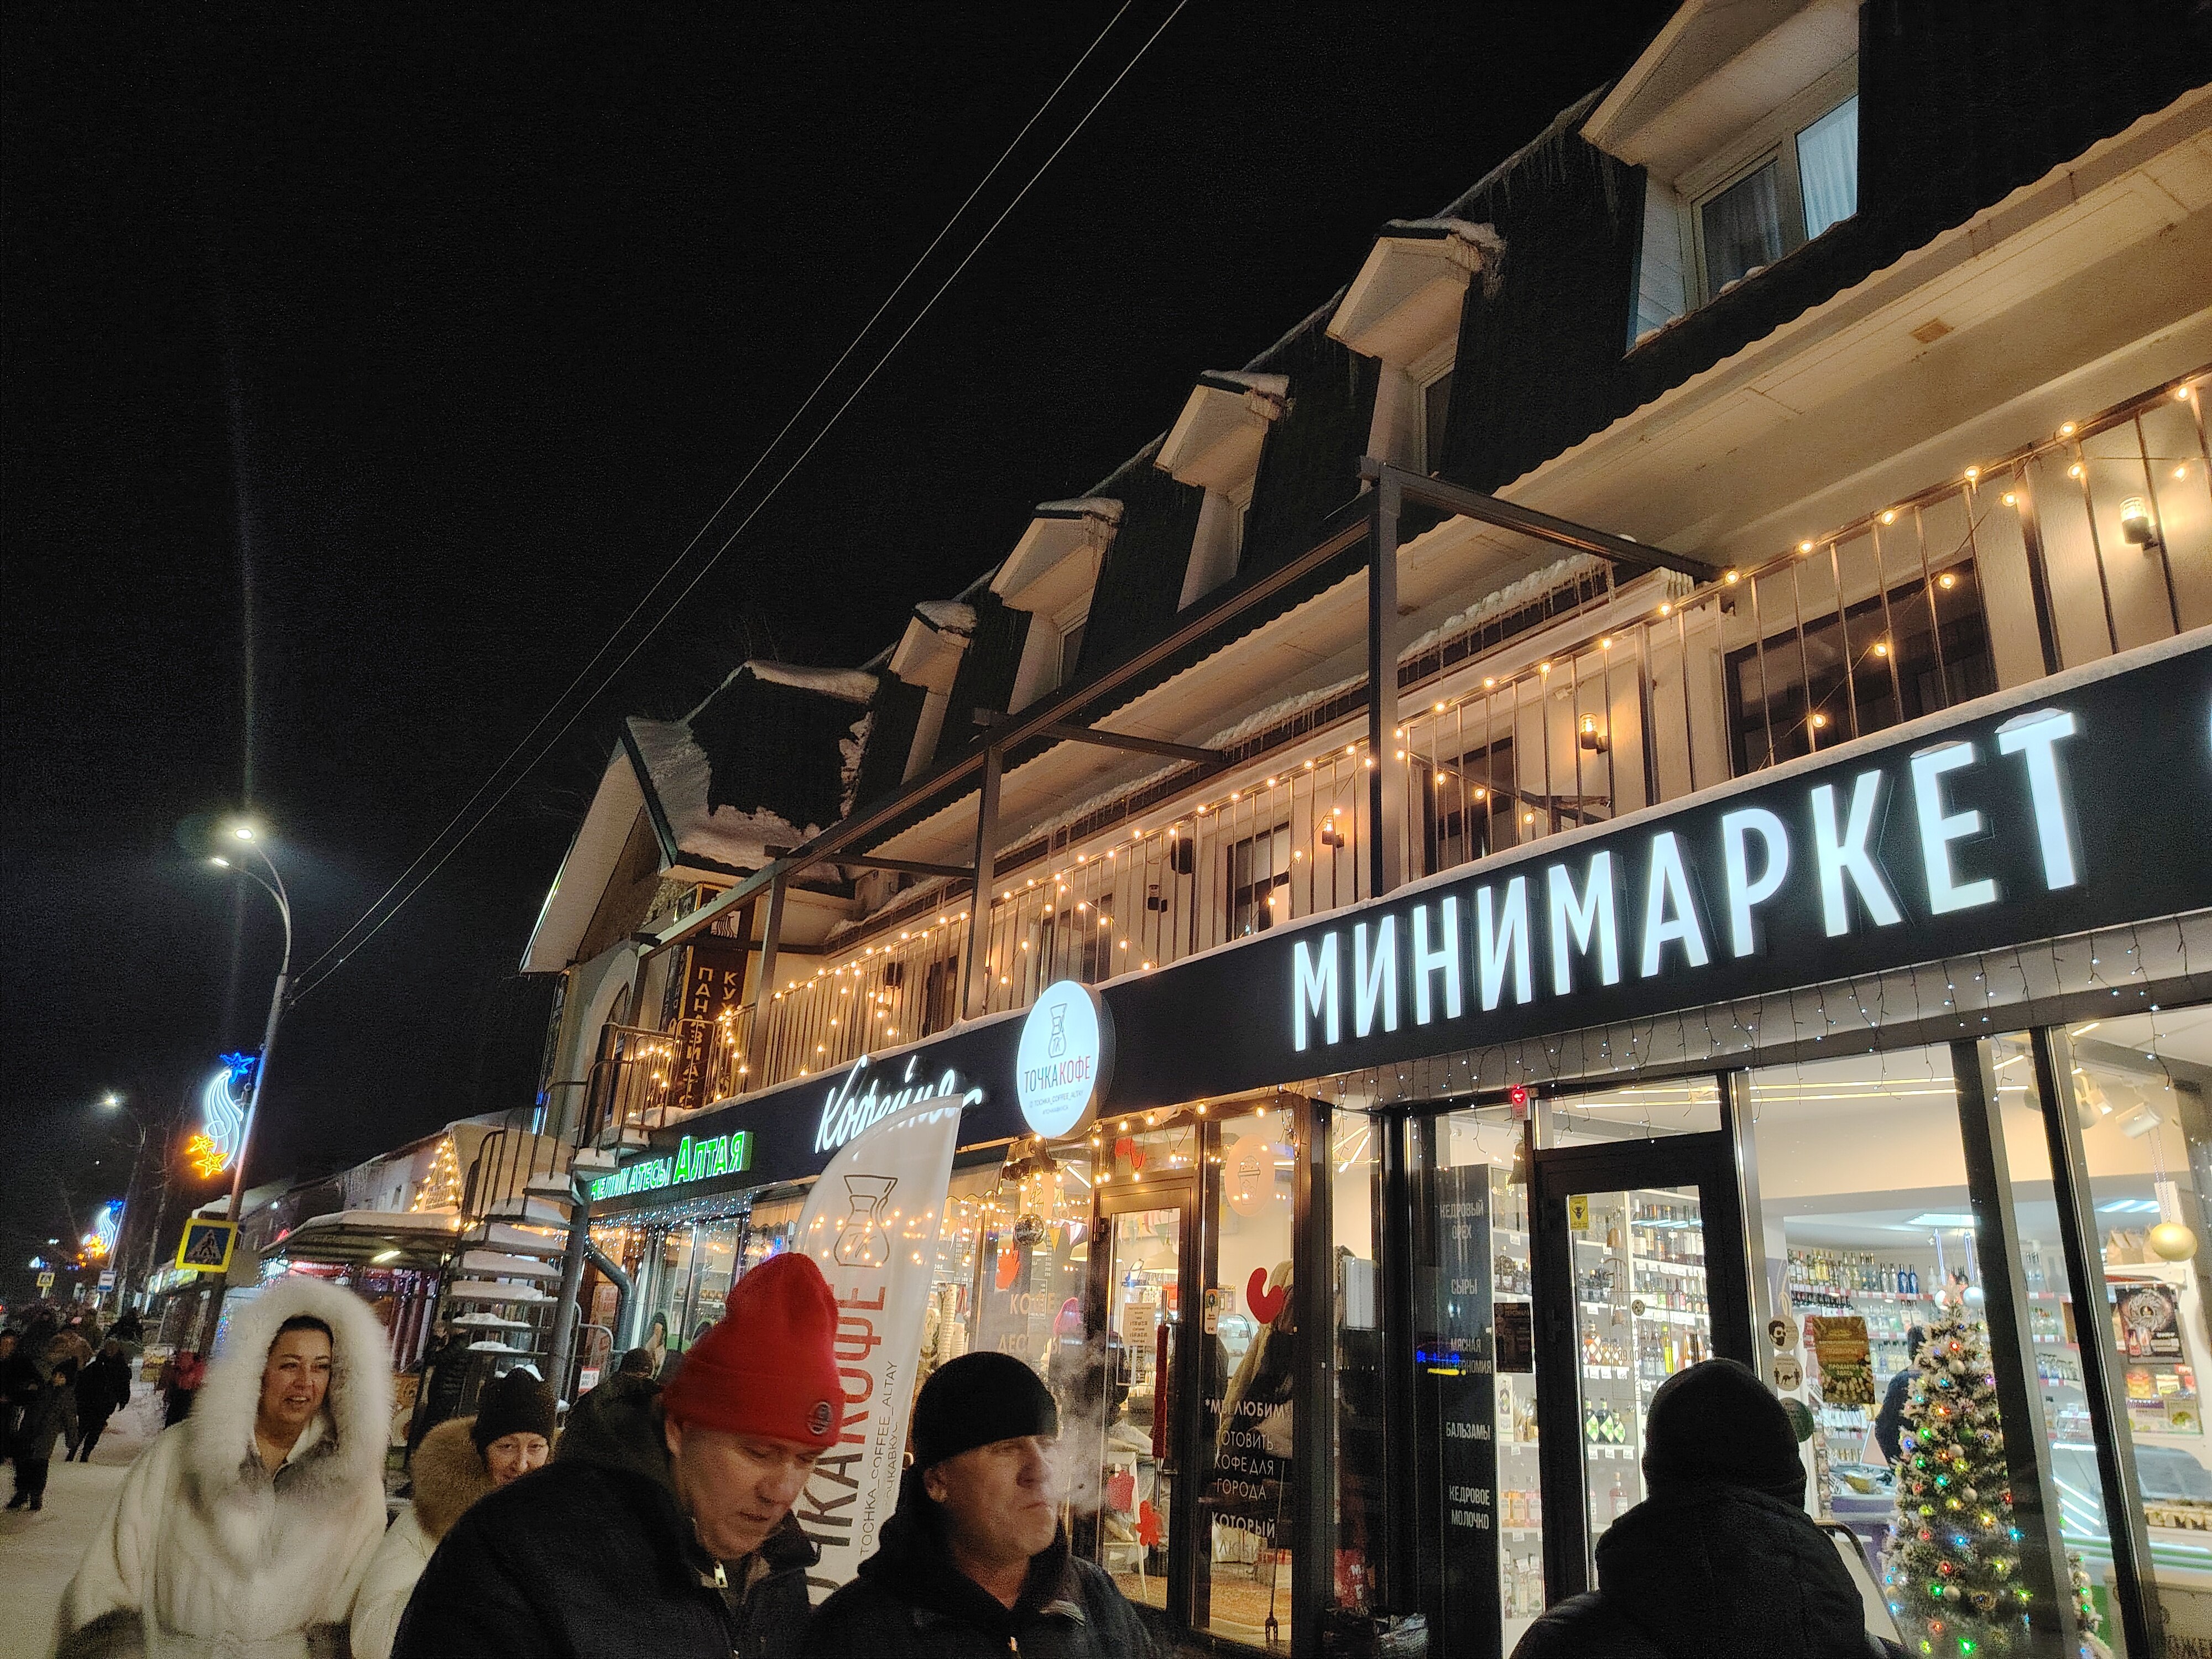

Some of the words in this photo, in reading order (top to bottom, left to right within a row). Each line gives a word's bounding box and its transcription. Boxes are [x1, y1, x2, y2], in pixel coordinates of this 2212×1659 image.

[1293, 712, 2078, 1053] МИНИМАРКЕТ
[1439, 1199, 1484, 1218] КЕДРОВЫЙ
[1452, 1224, 1472, 1239] ОРЕХ
[1451, 1278, 1478, 1295] СЫРЫ
[997, 1333, 1062, 1355] ДЕСЫ
[1450, 1337, 1482, 1353] МЯСНАЯ
[1234, 1401, 1285, 1420] ЛЮБИМ
[1446, 1421, 1491, 1441] БАЛЬЗАМЫ
[859, 1360, 898, 1557] TOCHKA_COFFEE_ALTAY
[1214, 1454, 1248, 1473] КОФЕ
[1249, 1458, 1274, 1476] ДЛЯ
[1217, 1478, 1267, 1501] ГОРОДА
[1449, 1484, 1490, 1506] КЕДРОВОЕ
[1211, 1511, 1275, 1538] КОТОРЫЙ
[1451, 1509, 1490, 1530] МОЛОЧКО
